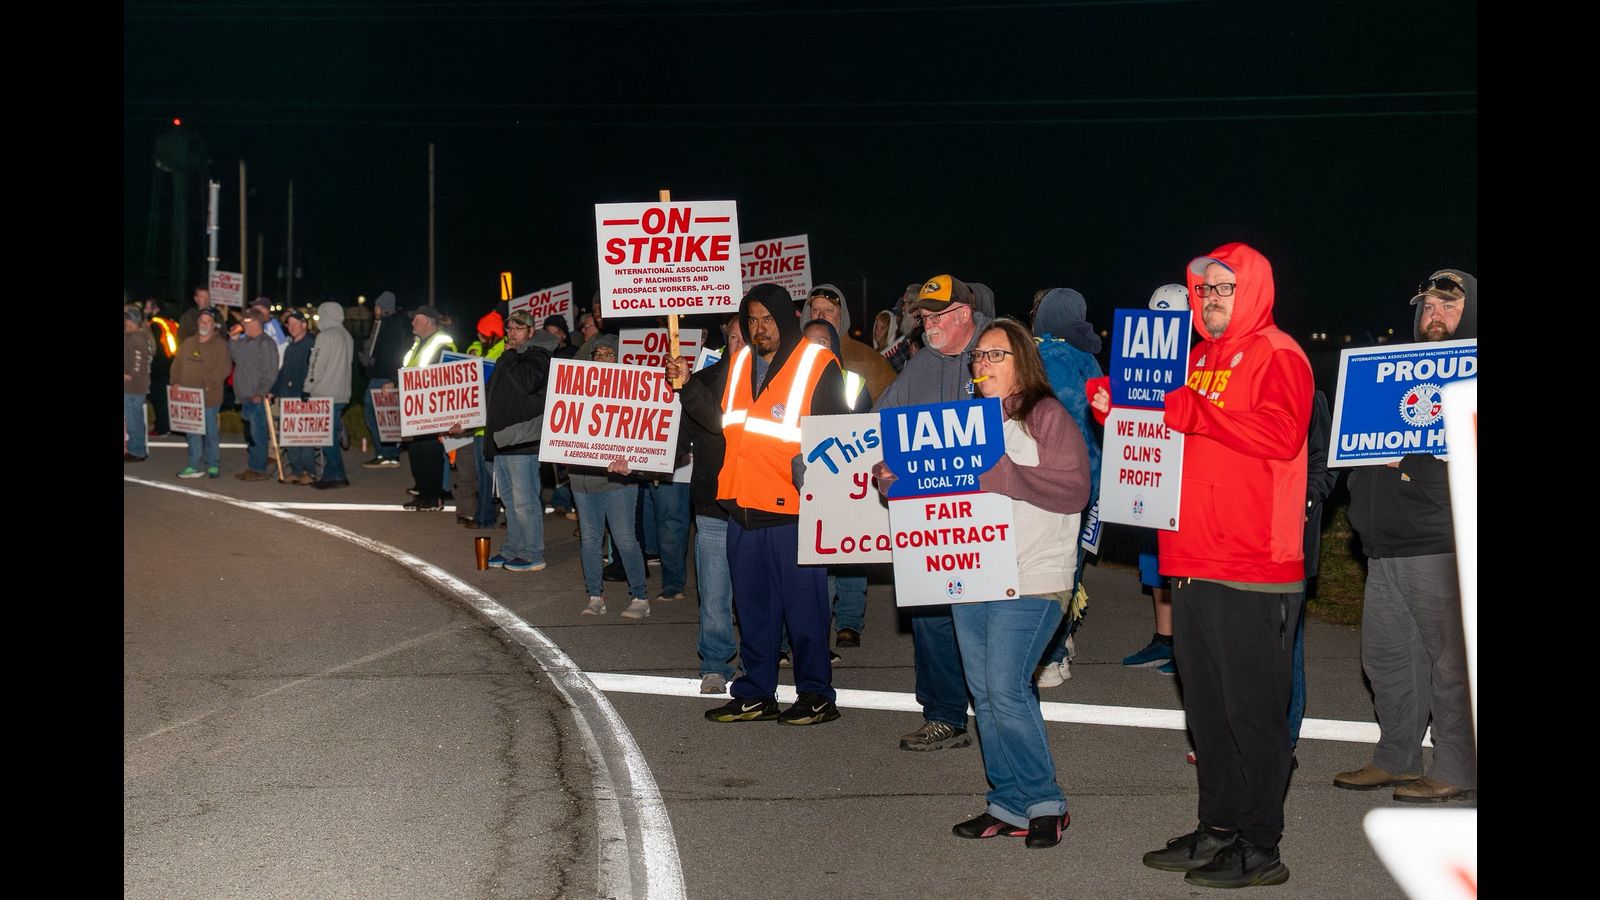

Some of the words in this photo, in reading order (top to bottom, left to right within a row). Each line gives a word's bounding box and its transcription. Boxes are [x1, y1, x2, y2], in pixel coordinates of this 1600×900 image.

[641, 207, 692, 235] ON
[604, 235, 732, 265] STRIKE
[754, 241, 782, 260] ON
[676, 265, 725, 273] ASSOCIATION
[741, 255, 806, 278] STRIKE
[612, 286, 658, 294] AEROSPACE
[659, 285, 699, 293] WORKERS,
[701, 283, 730, 291] AFL-CIO
[645, 276, 691, 284] MACHINISTS
[528, 290, 551, 308] ON
[612, 299, 655, 310] LOCAL
[659, 297, 704, 308] LODGE
[707, 296, 731, 306] 778
[644, 332, 669, 353] ON
[1122, 316, 1180, 360] IAM
[1351, 355, 1387, 363] INTERNATIONAL
[1387, 352, 1418, 360] ASSOCIATION
[403, 361, 478, 391] MACHINISTS
[1124, 367, 1172, 384] UNION
[1376, 356, 1477, 383] PROUD
[555, 364, 674, 404] MACHINISTS
[404, 394, 424, 417] ON
[429, 386, 479, 413] STRIKE
[1128, 387, 1151, 401] LOCAL
[1152, 389, 1165, 402] 778
[284, 399, 330, 414] MACHINISTS
[283, 417, 296, 432] ON
[298, 417, 330, 432] STRIKE
[549, 400, 584, 434] ON
[587, 403, 673, 442] STRIKE
[897, 405, 987, 452] IAM
[1117, 420, 1134, 437] WE
[1137, 422, 1171, 440] MAKE
[548, 440, 590, 449] INTERNATIONAL
[591, 443, 626, 453] ASSOCIATION
[635, 446, 667, 456] MACHINISTS
[1341, 429, 1422, 451] UNION
[1426, 428, 1448, 447] H
[569, 450, 599, 459] AEROSPACE
[628, 455, 649, 464] AFL-CIO
[808, 428, 880, 474] This
[1123, 444, 1161, 463] OLIN'S
[907, 454, 983, 473] UNION
[918, 477, 952, 490] LOCAL
[954, 474, 975, 487] 778
[1119, 468, 1162, 488] PROFIT
[925, 501, 973, 521] FAIR
[895, 524, 1009, 549] CONTRACT
[926, 552, 981, 572] NOW!
